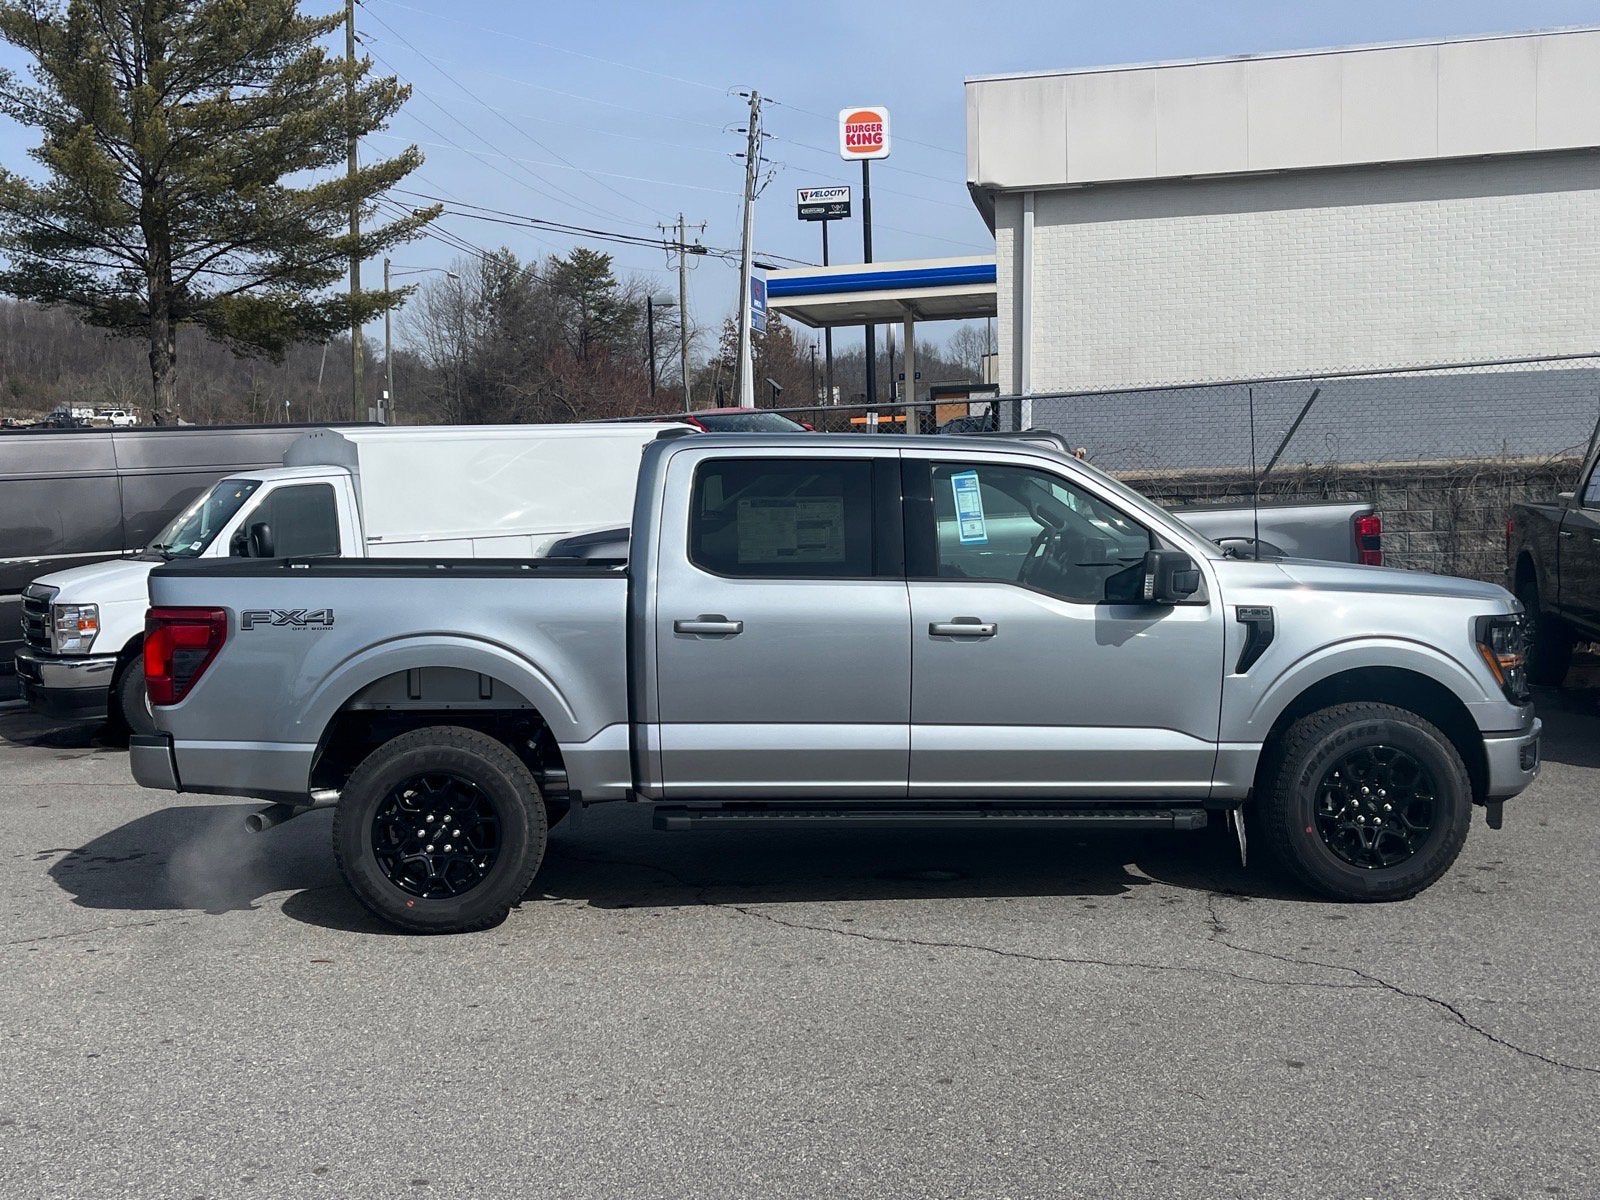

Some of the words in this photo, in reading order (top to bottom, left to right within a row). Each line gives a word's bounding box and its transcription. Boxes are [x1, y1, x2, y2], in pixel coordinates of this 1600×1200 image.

[846, 124, 882, 133] BURGER
[846, 133, 882, 145] KING
[241, 609, 334, 630] FX4
